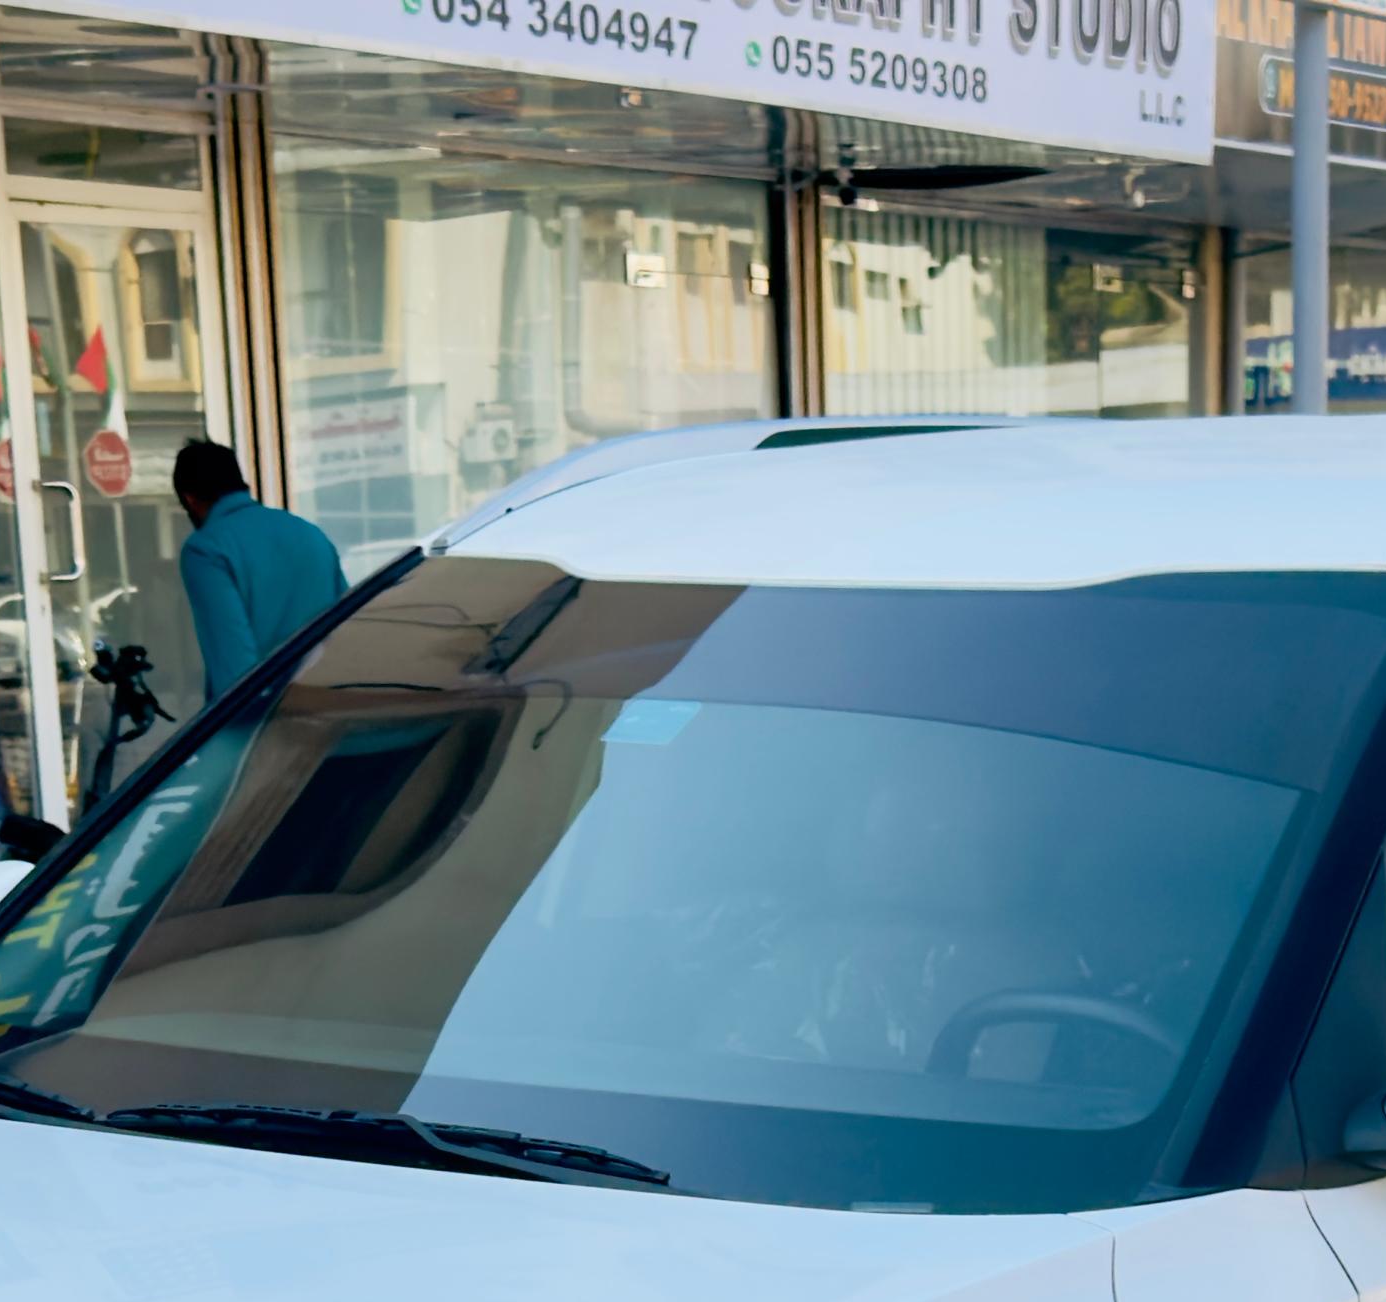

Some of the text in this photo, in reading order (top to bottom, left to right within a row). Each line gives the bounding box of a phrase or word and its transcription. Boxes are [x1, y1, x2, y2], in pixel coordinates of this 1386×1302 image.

[433, 0, 510, 31] 054
[528, 0, 698, 61] 3404947
[1010, 0, 1183, 73] STUDIO
[772, 35, 988, 103] 055 5209308
